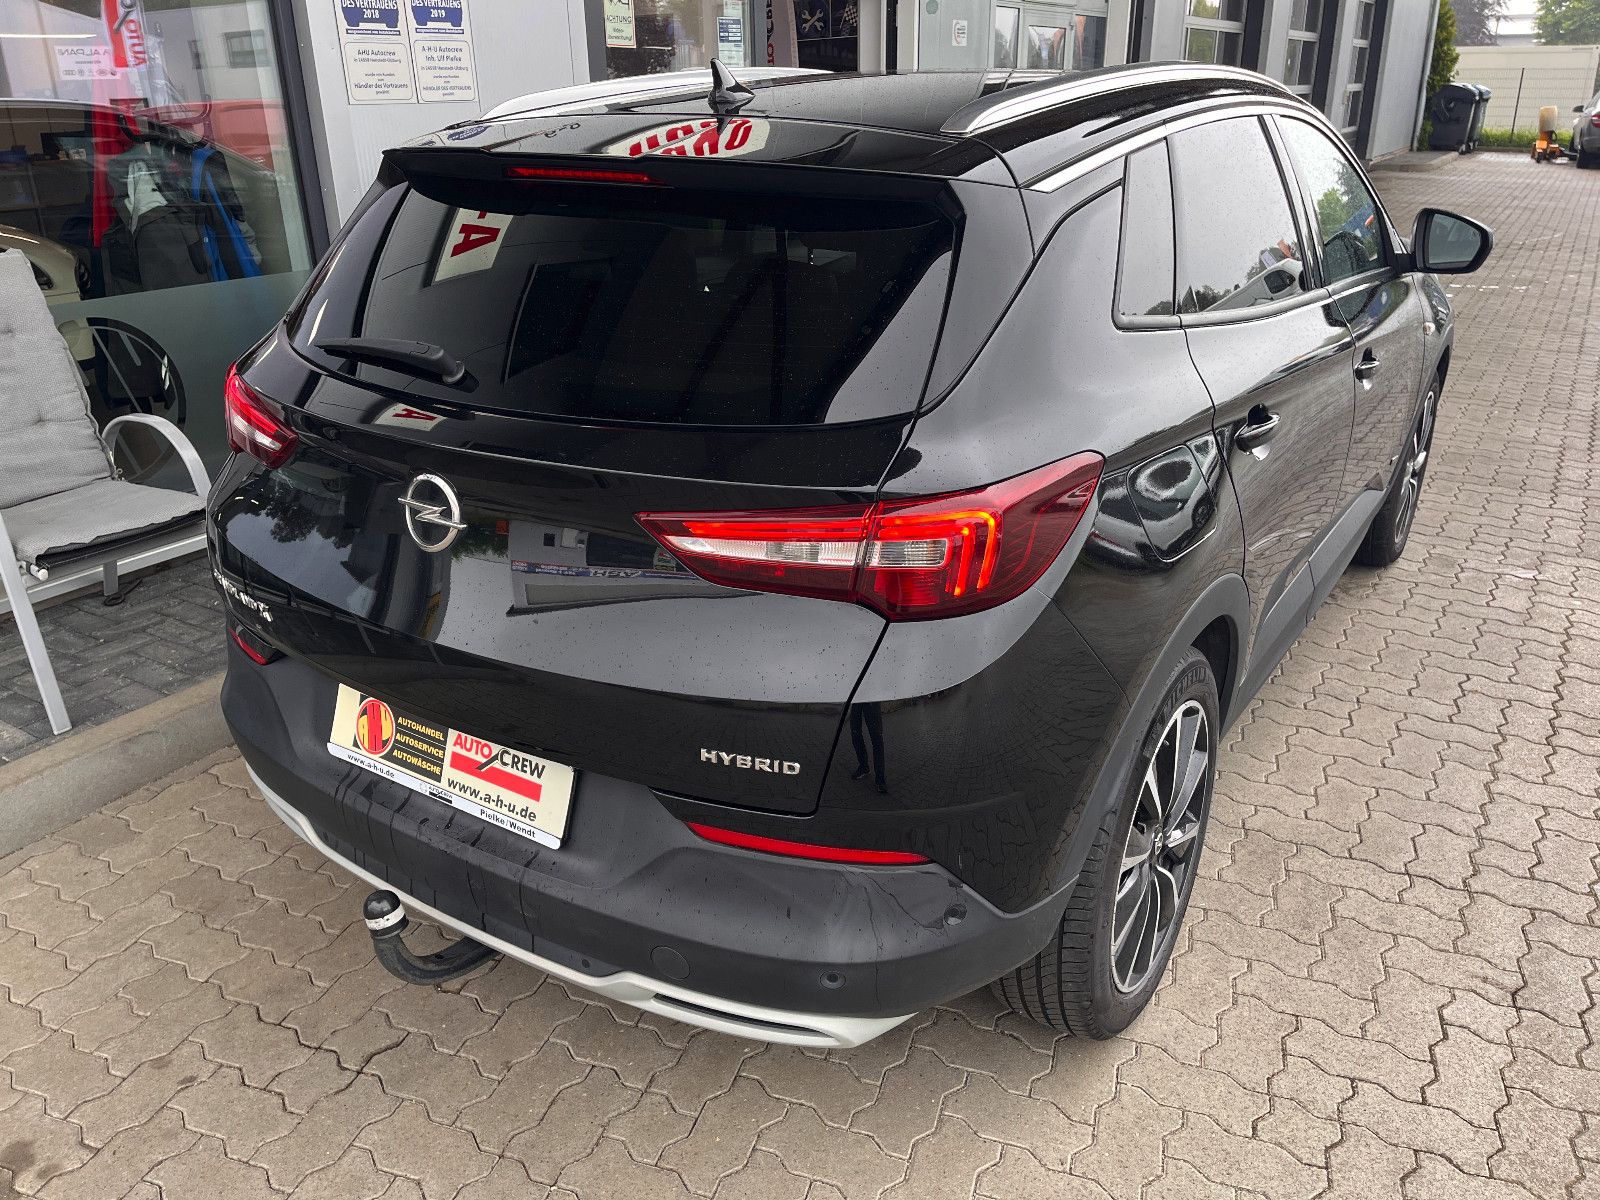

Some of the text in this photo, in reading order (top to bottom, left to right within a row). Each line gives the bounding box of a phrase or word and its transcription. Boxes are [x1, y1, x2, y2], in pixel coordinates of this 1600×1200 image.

[355, 0, 397, 10] VERTRAUENS
[363, 9, 380, 19] 2018
[424, 0, 461, 9] VERTRAUENS
[430, 9, 446, 18] 2019
[606, 15, 632, 23] ACHTUNG
[397, 716, 445, 741] AUTOHANDEL
[395, 732, 444, 758] AUTOSERVICE
[453, 733, 546, 779] AUTO CREW
[347, 753, 395, 778] www.a-h-u.de
[392, 749, 442, 775] AUTOWÄSCHE
[700, 747, 801, 775] HYBRID
[447, 777, 537, 822] www.a-h-u.de
[480, 808, 537, 838] Pielke/Wendt
